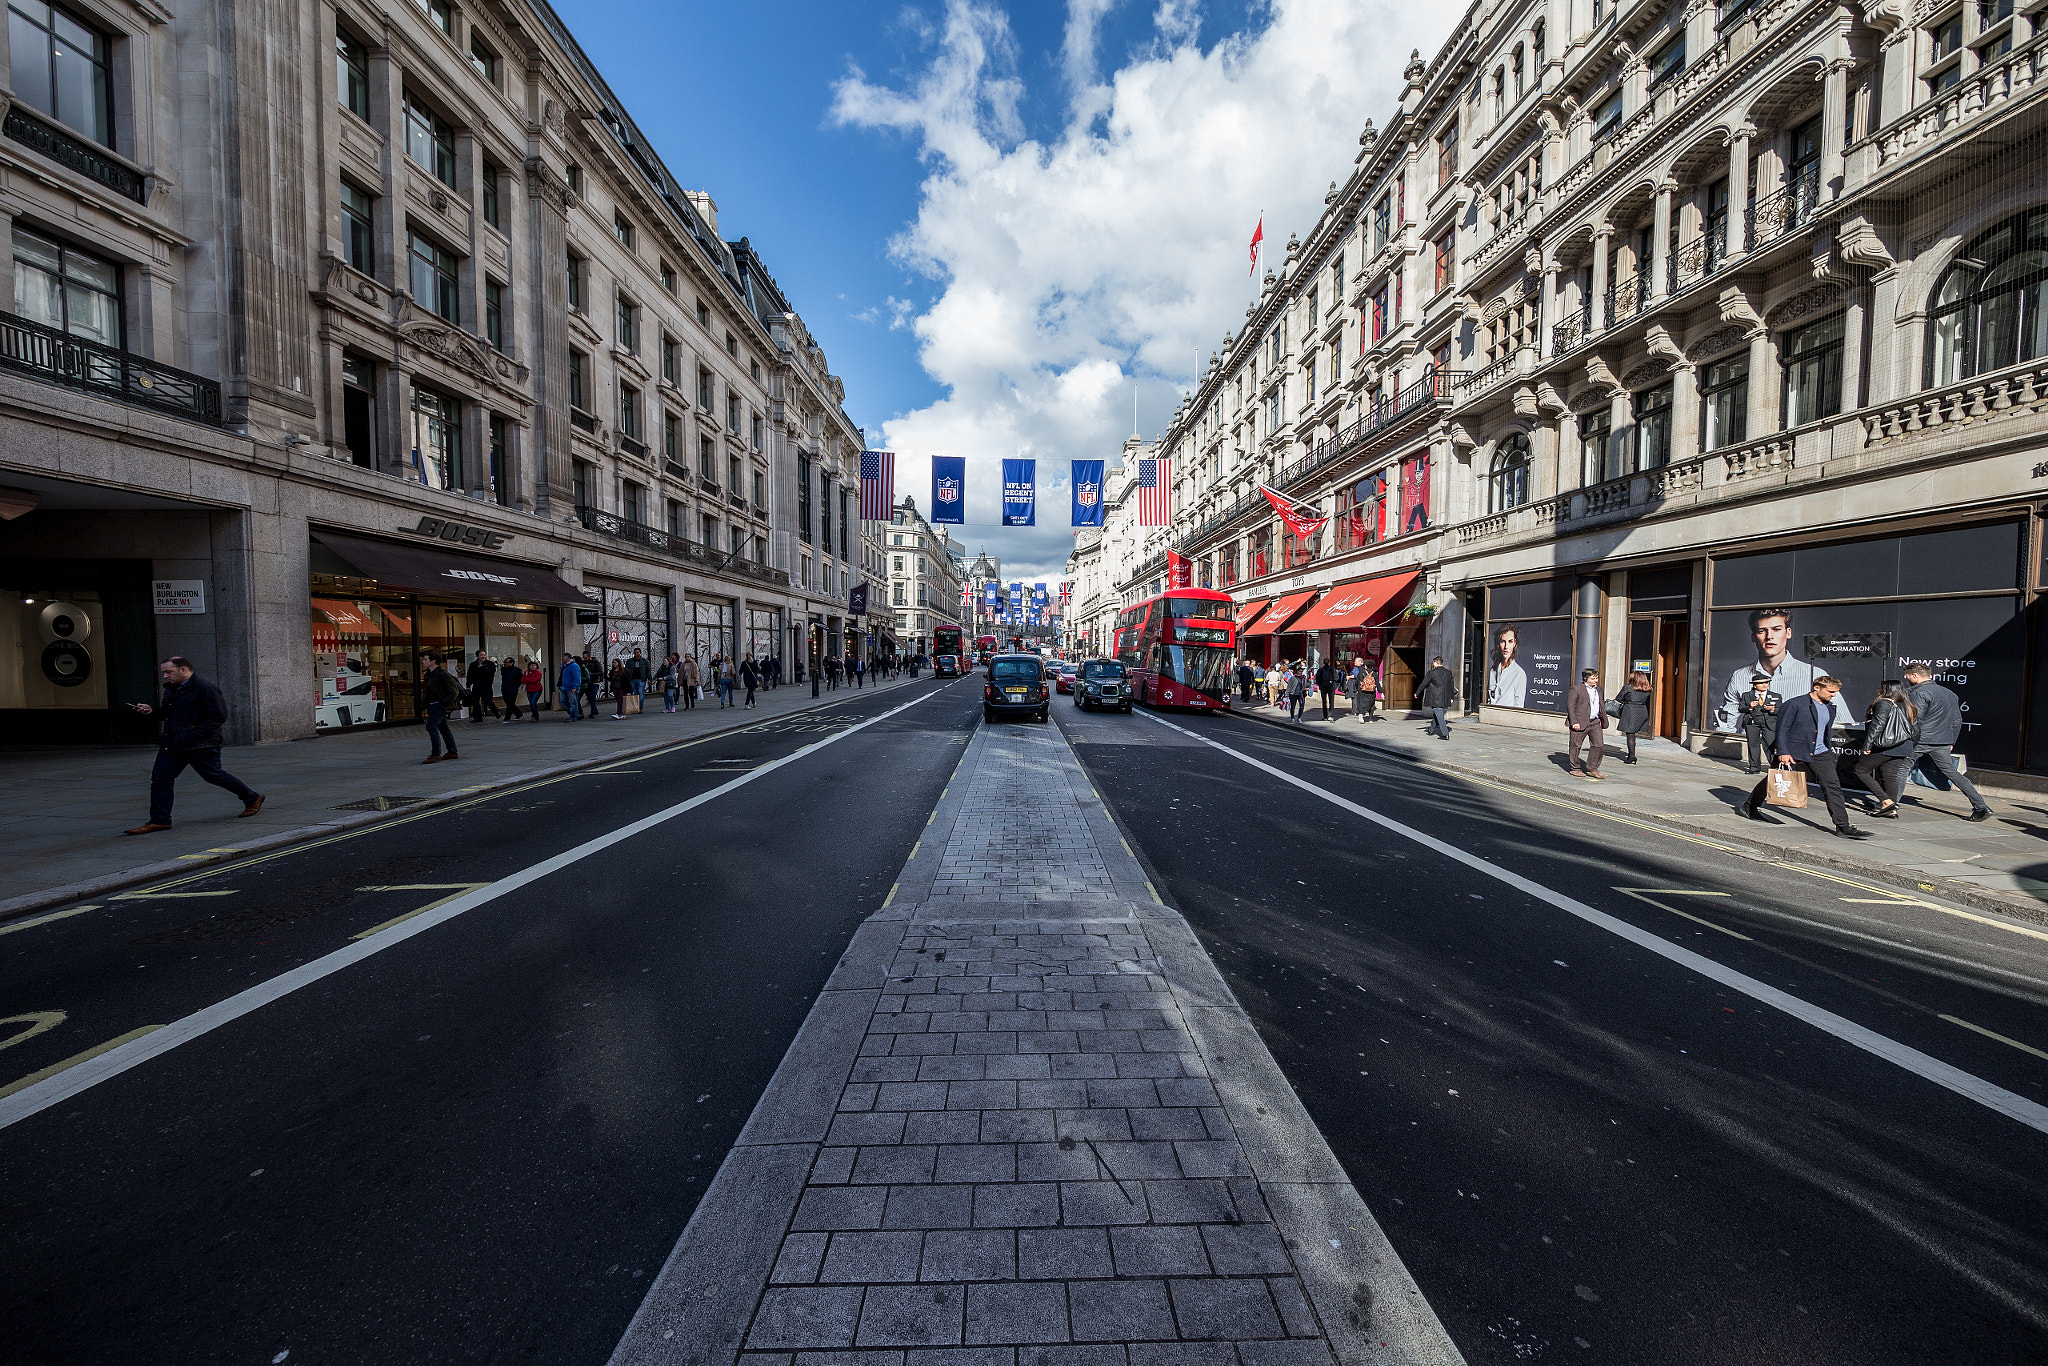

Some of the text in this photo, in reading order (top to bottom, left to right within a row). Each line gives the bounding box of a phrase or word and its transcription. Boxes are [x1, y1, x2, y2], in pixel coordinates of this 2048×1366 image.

[940, 488, 955, 499] NFL
[1080, 492, 1095, 503] NFL
[398, 516, 515, 549] BOSE
[441, 569, 520, 585] BOSE
[1292, 576, 1305, 587] TOYS
[1323, 594, 1371, 616] Hamleys
[1213, 632, 1225, 641] 453
[1535, 662, 1558, 670] opening
[1936, 657, 1976, 668] store
[1530, 688, 1563, 696] GANT
[790, 715, 864, 723] BUS
[741, 724, 853, 733] STOP
